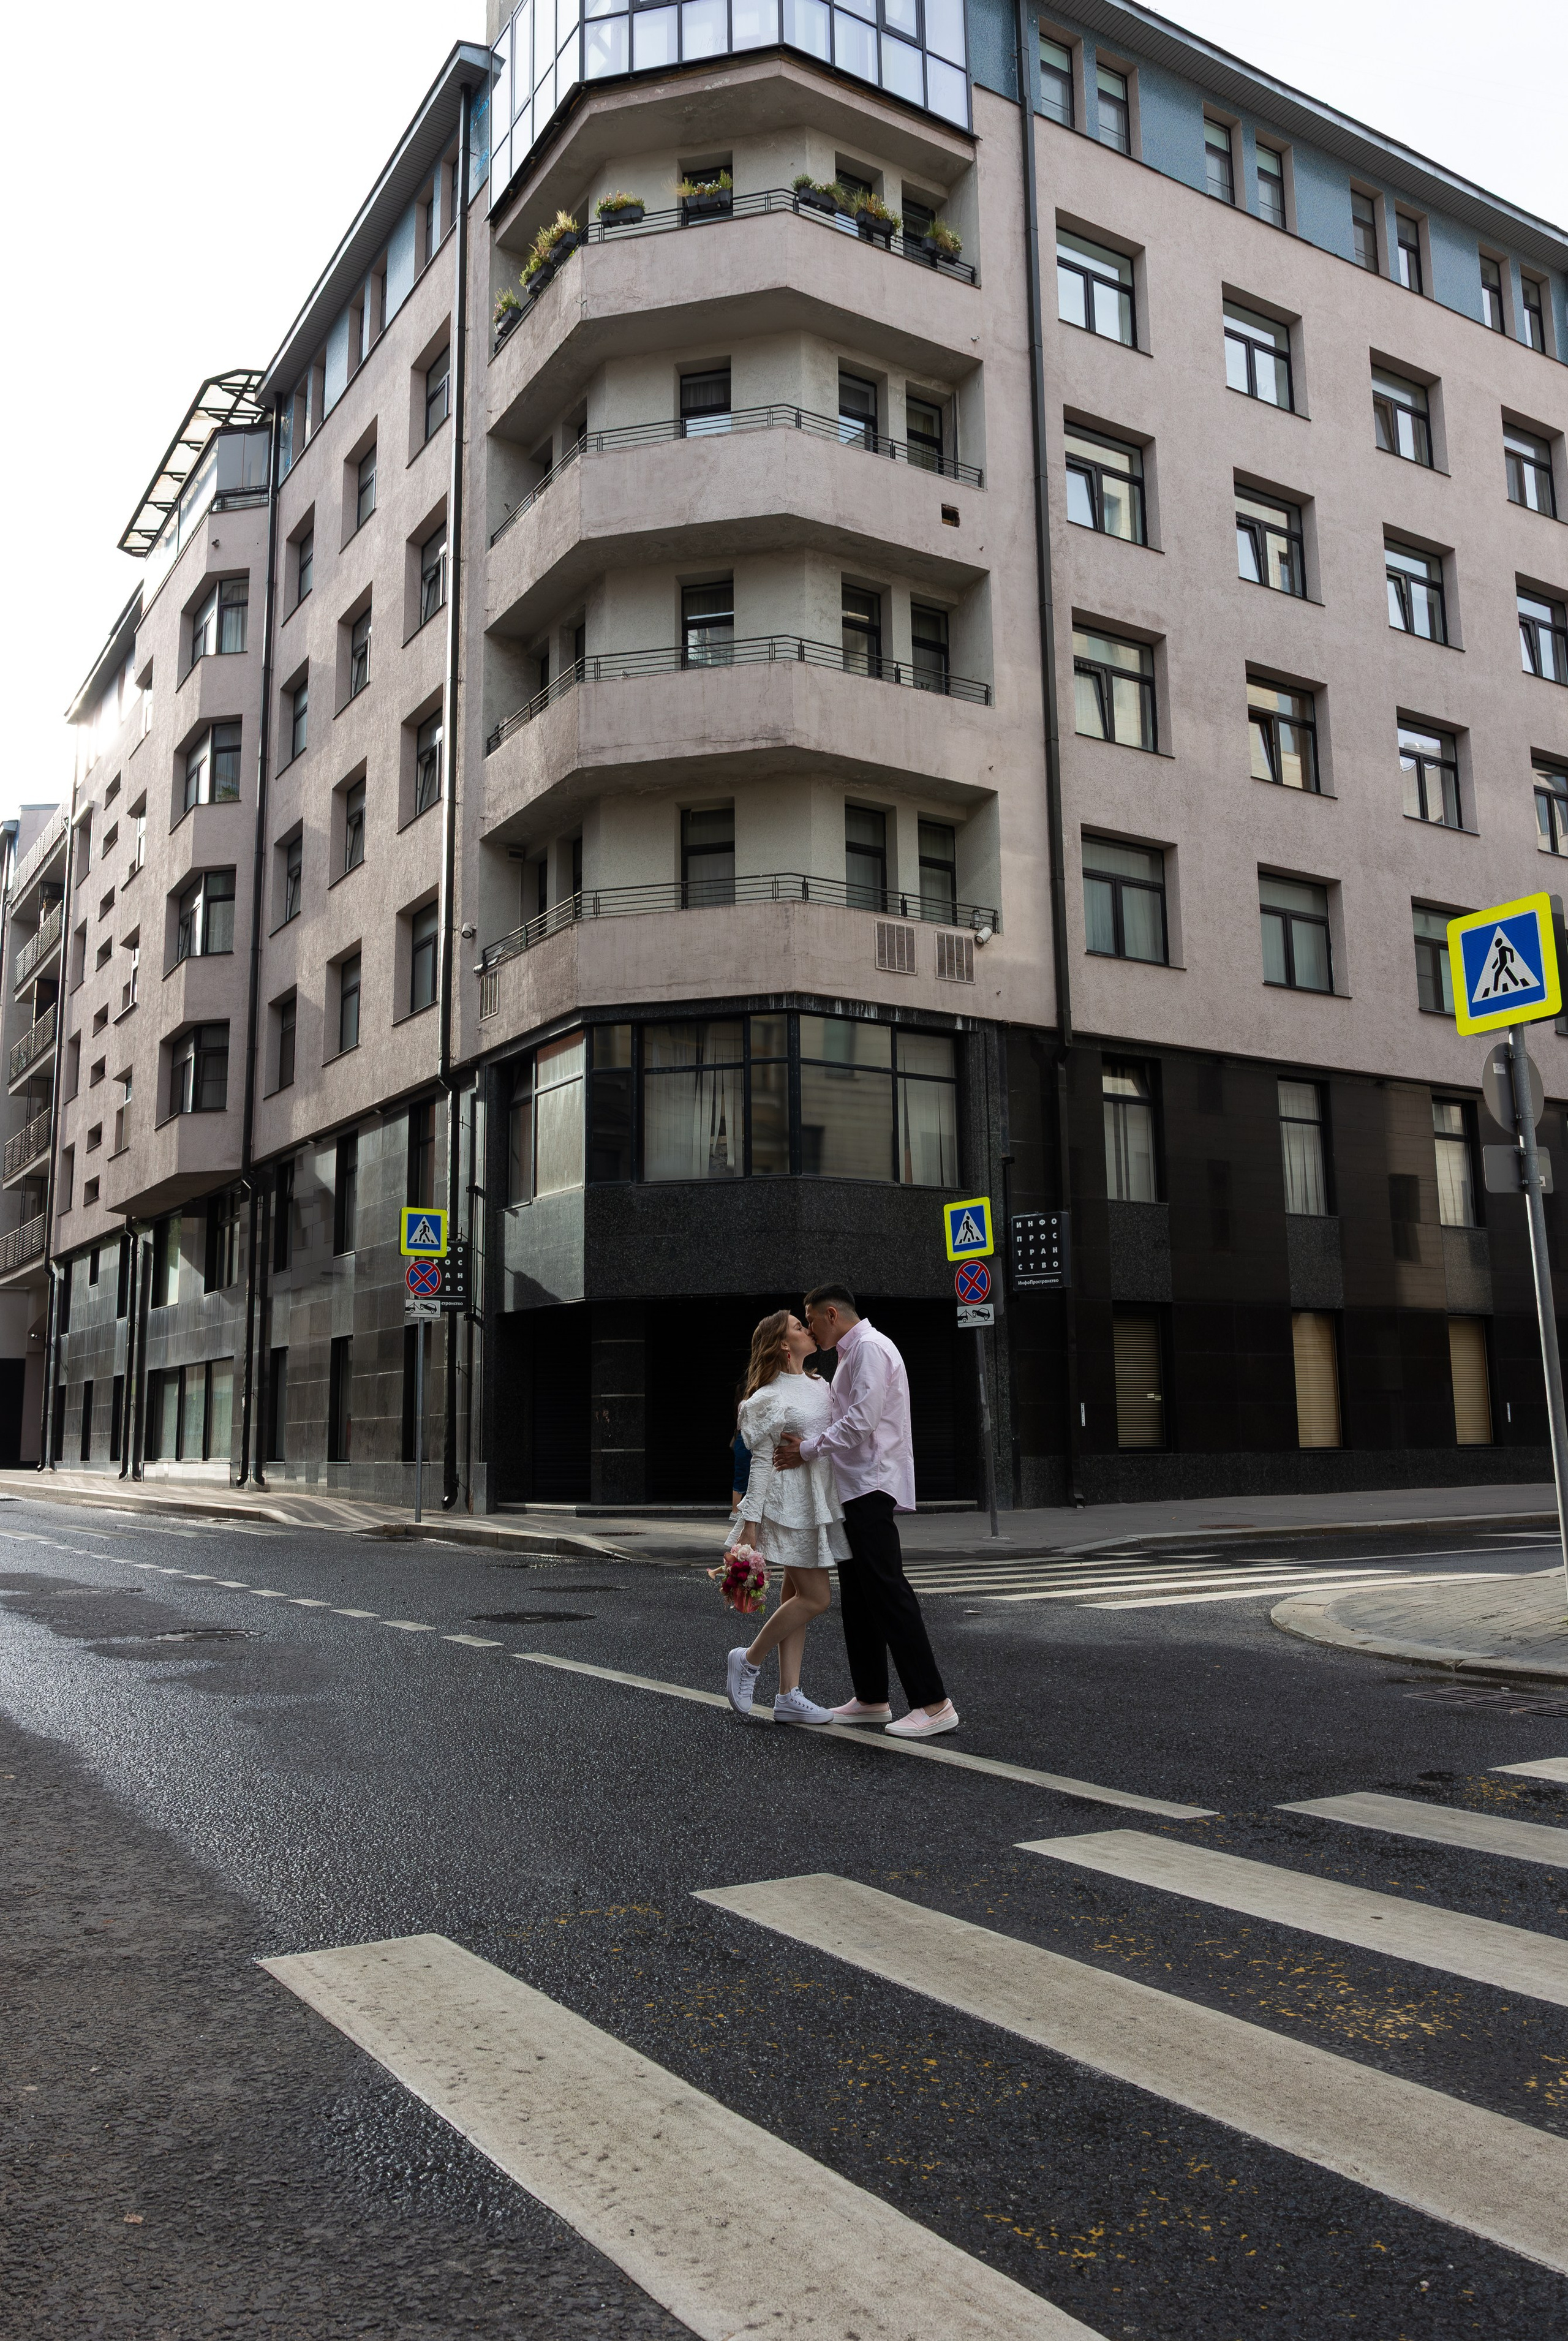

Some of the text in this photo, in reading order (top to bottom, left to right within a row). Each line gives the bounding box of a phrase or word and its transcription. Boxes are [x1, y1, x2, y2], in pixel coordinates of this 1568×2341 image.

[1016, 1218, 1057, 1228] ИНФО
[1017, 1232, 1057, 1242] ПРОС
[1017, 1246, 1058, 1256] ТРАН
[1018, 1261, 1058, 1270] СТВО
